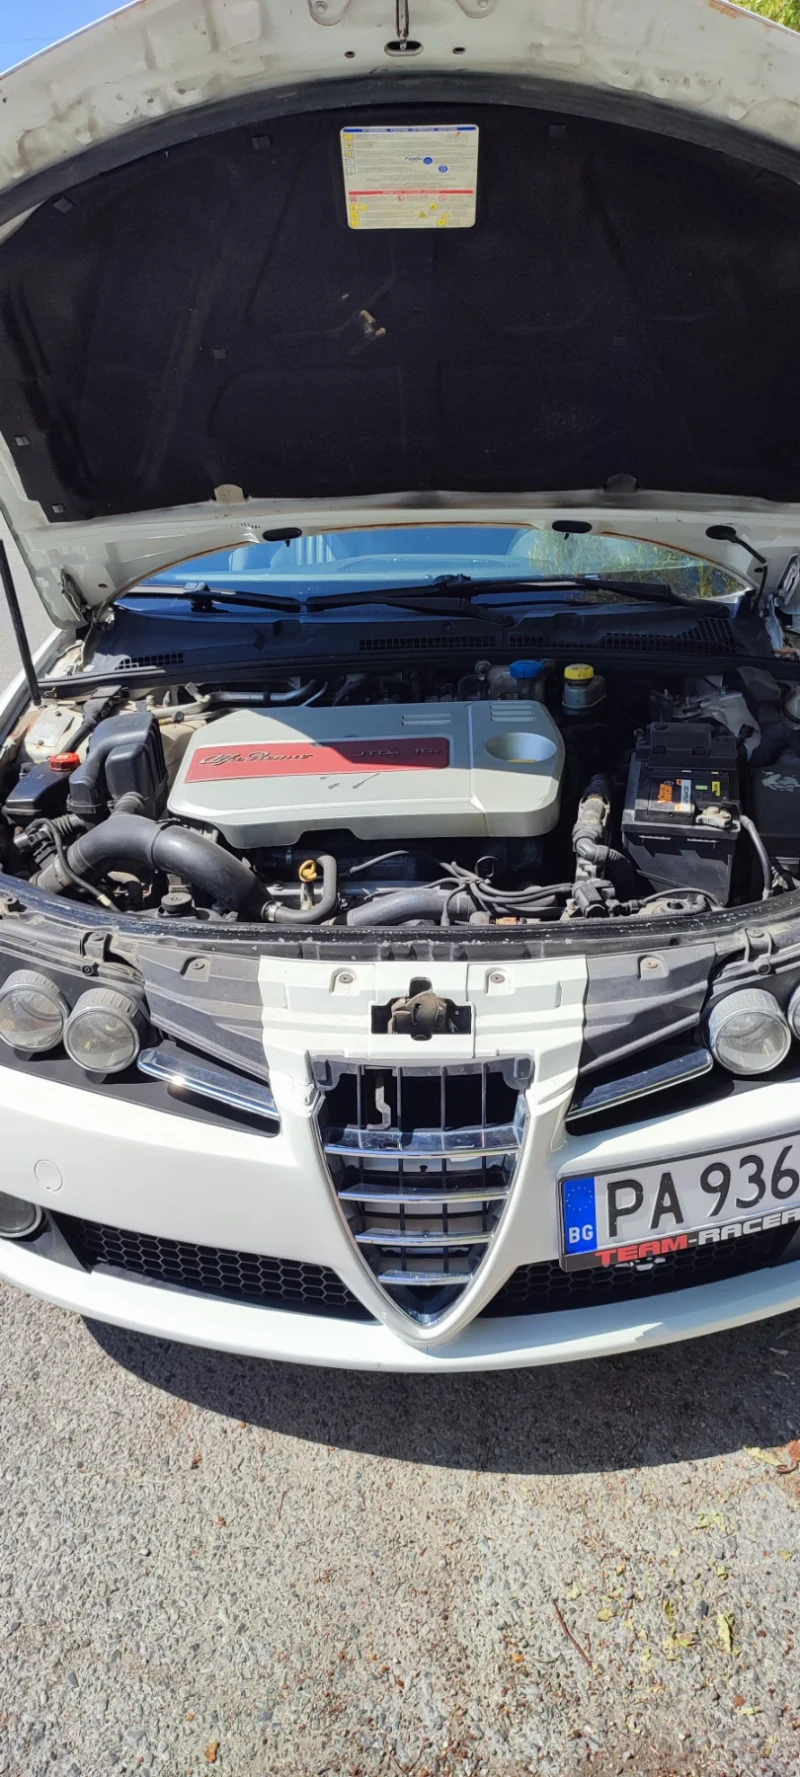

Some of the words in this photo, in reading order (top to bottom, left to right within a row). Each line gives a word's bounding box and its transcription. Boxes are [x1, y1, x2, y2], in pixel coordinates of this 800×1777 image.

[199, 753, 245, 766] Alfa
[245, 750, 313, 762] Romeo
[607, 1172, 684, 1238] PA
[700, 1145, 800, 1217] 936
[569, 1225, 594, 1244] BG
